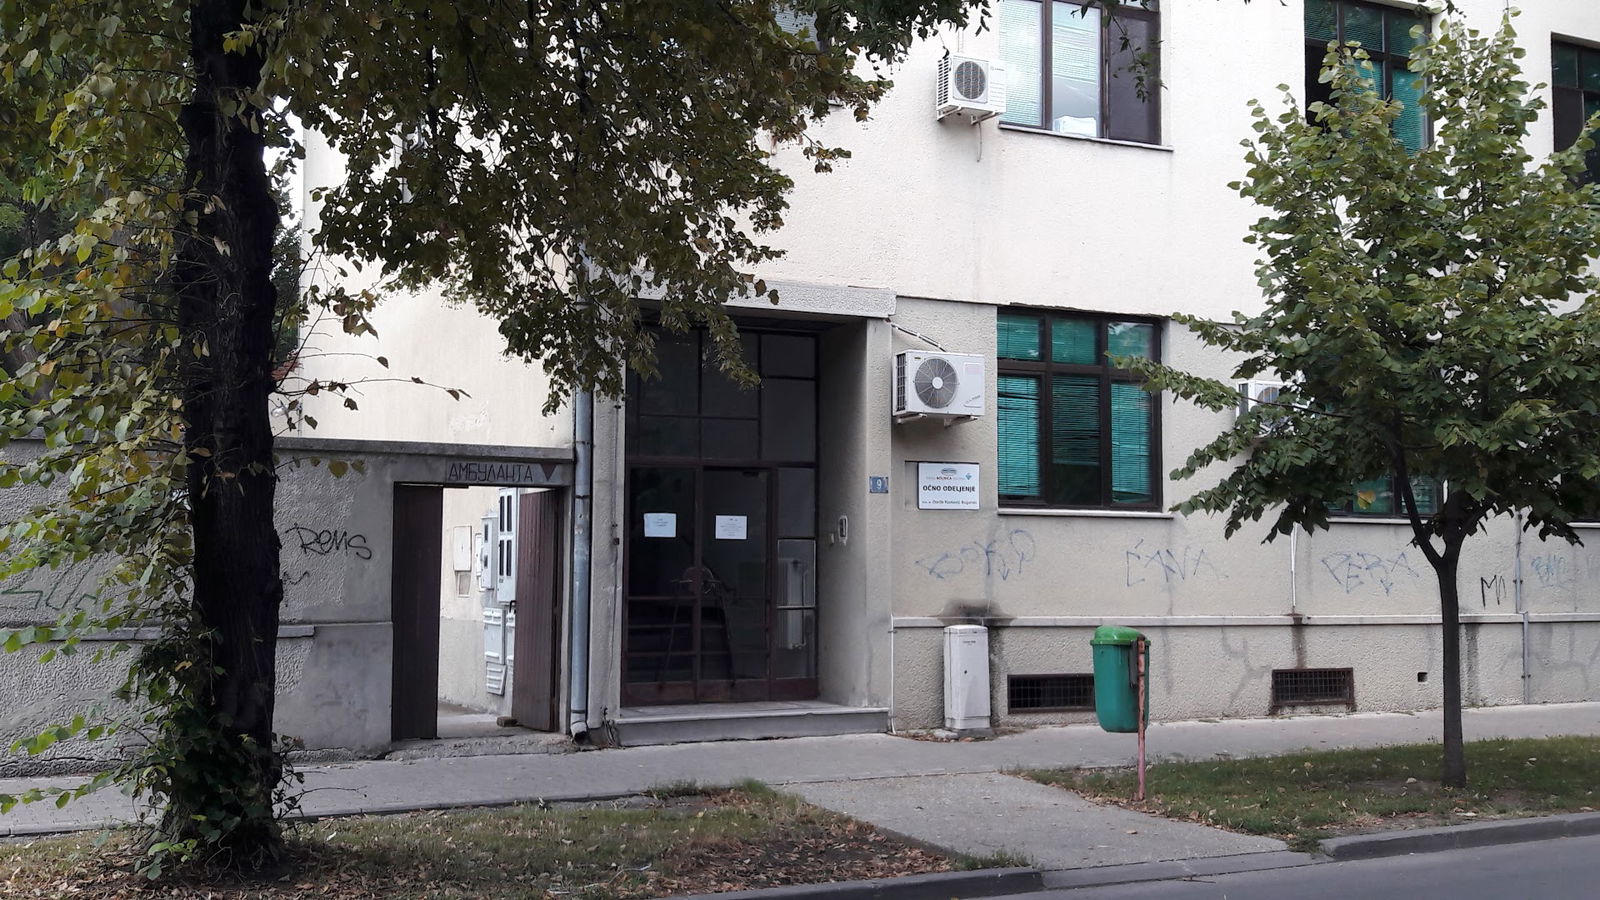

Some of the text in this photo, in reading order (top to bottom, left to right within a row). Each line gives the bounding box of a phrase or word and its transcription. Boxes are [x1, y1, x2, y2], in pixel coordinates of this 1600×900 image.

[448, 463, 533, 482] АМБУЛАНТА
[876, 479, 882, 489] 9
[922, 484, 976, 493] OČNO ODELJENJE
